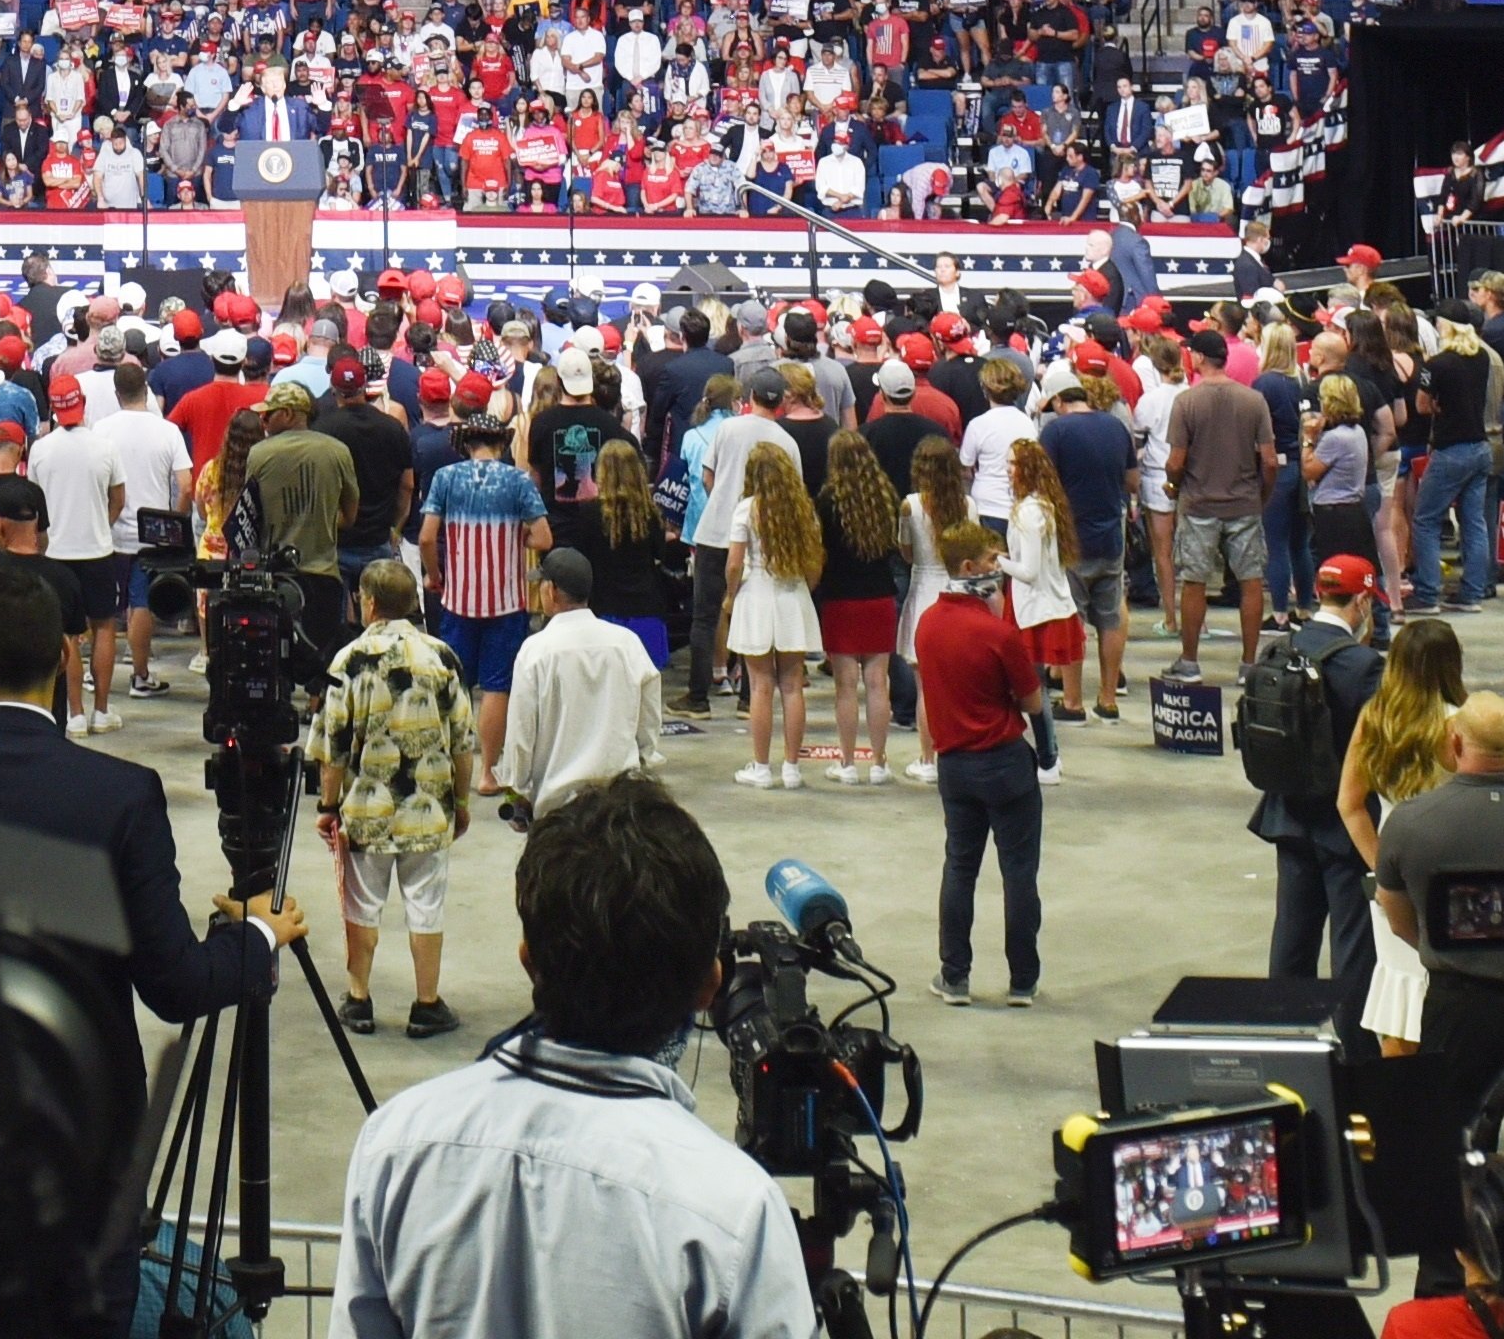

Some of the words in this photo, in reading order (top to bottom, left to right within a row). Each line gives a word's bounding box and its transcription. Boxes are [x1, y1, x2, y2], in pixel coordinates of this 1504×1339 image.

[63, 7, 97, 18] AMERICA
[110, 12, 141, 20] AMERICA
[521, 145, 557, 157] AMERICA
[1162, 692, 1191, 707] MAKE
[1154, 703, 1218, 728] AMERICA
[1154, 721, 1175, 740] GREAT
[1175, 728, 1219, 744] AGAIN
